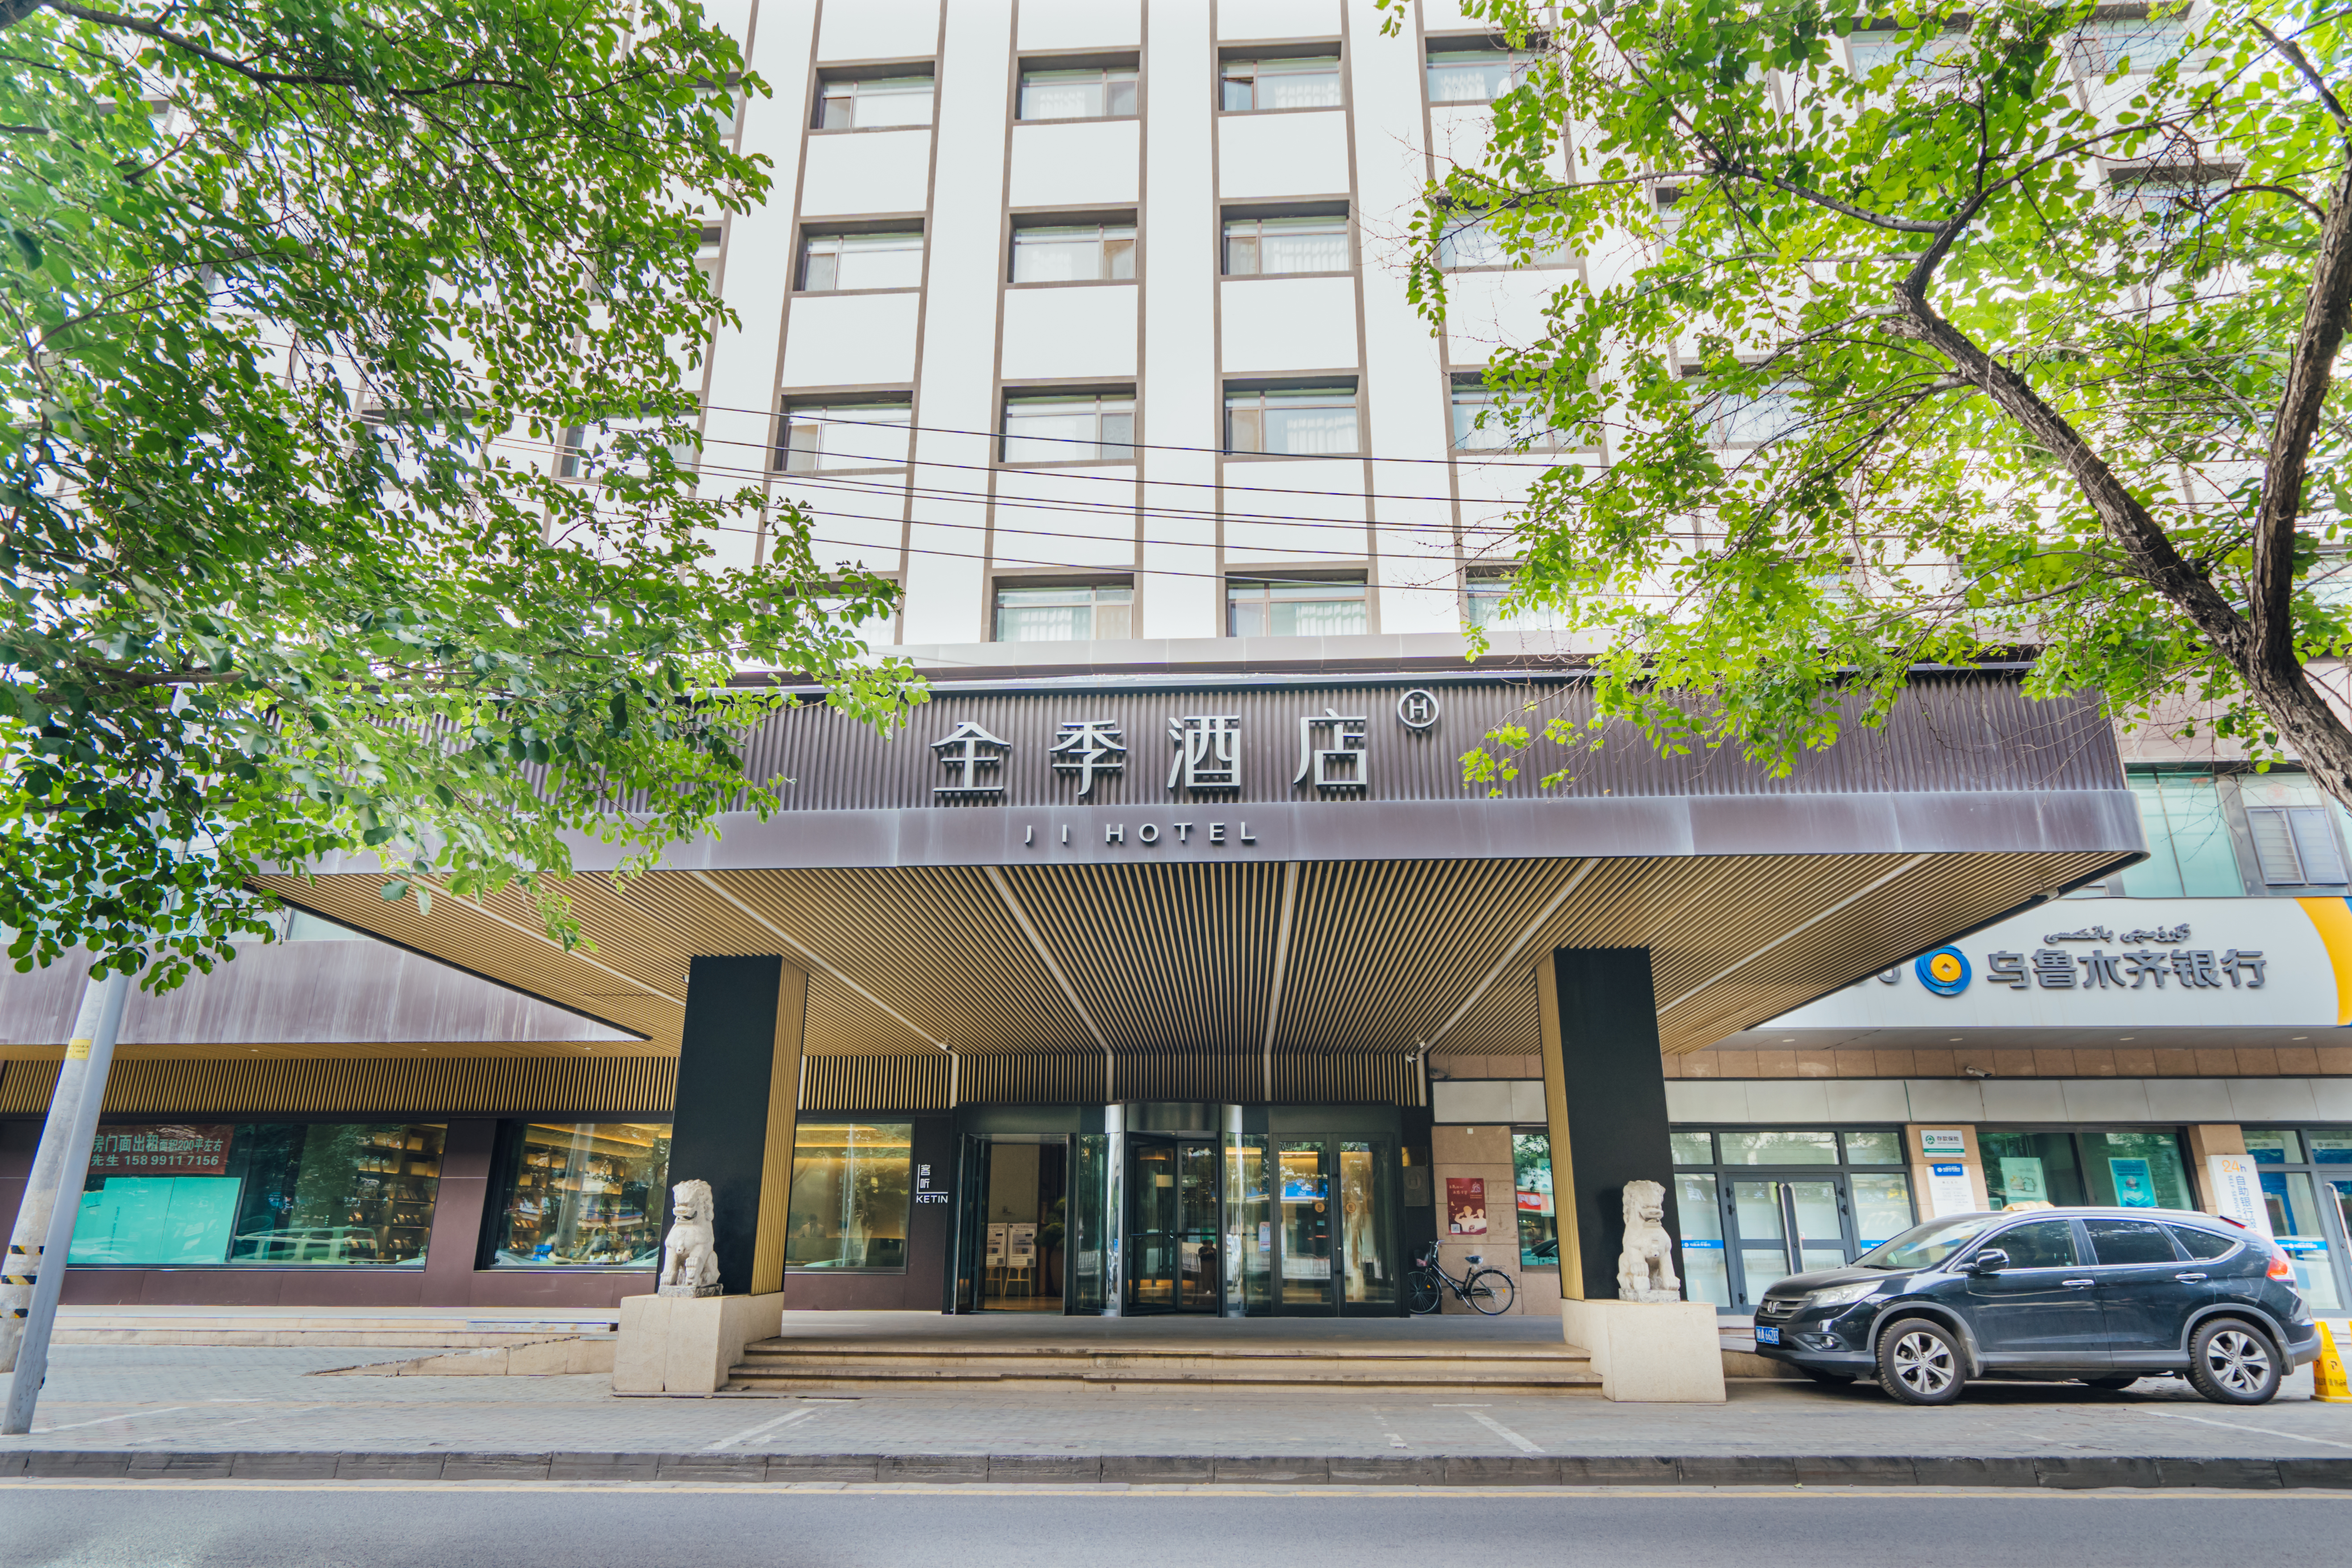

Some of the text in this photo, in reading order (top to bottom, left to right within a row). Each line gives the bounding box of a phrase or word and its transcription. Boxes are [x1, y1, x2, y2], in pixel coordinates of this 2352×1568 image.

[930, 708, 1368, 797] 全季酒店
[1106, 821, 1256, 843] HOTEL
[1987, 949, 2267, 988] 乌鲁木齐银行
[91, 1154, 119, 1166] 先生
[916, 1195, 948, 1203] KETIN
